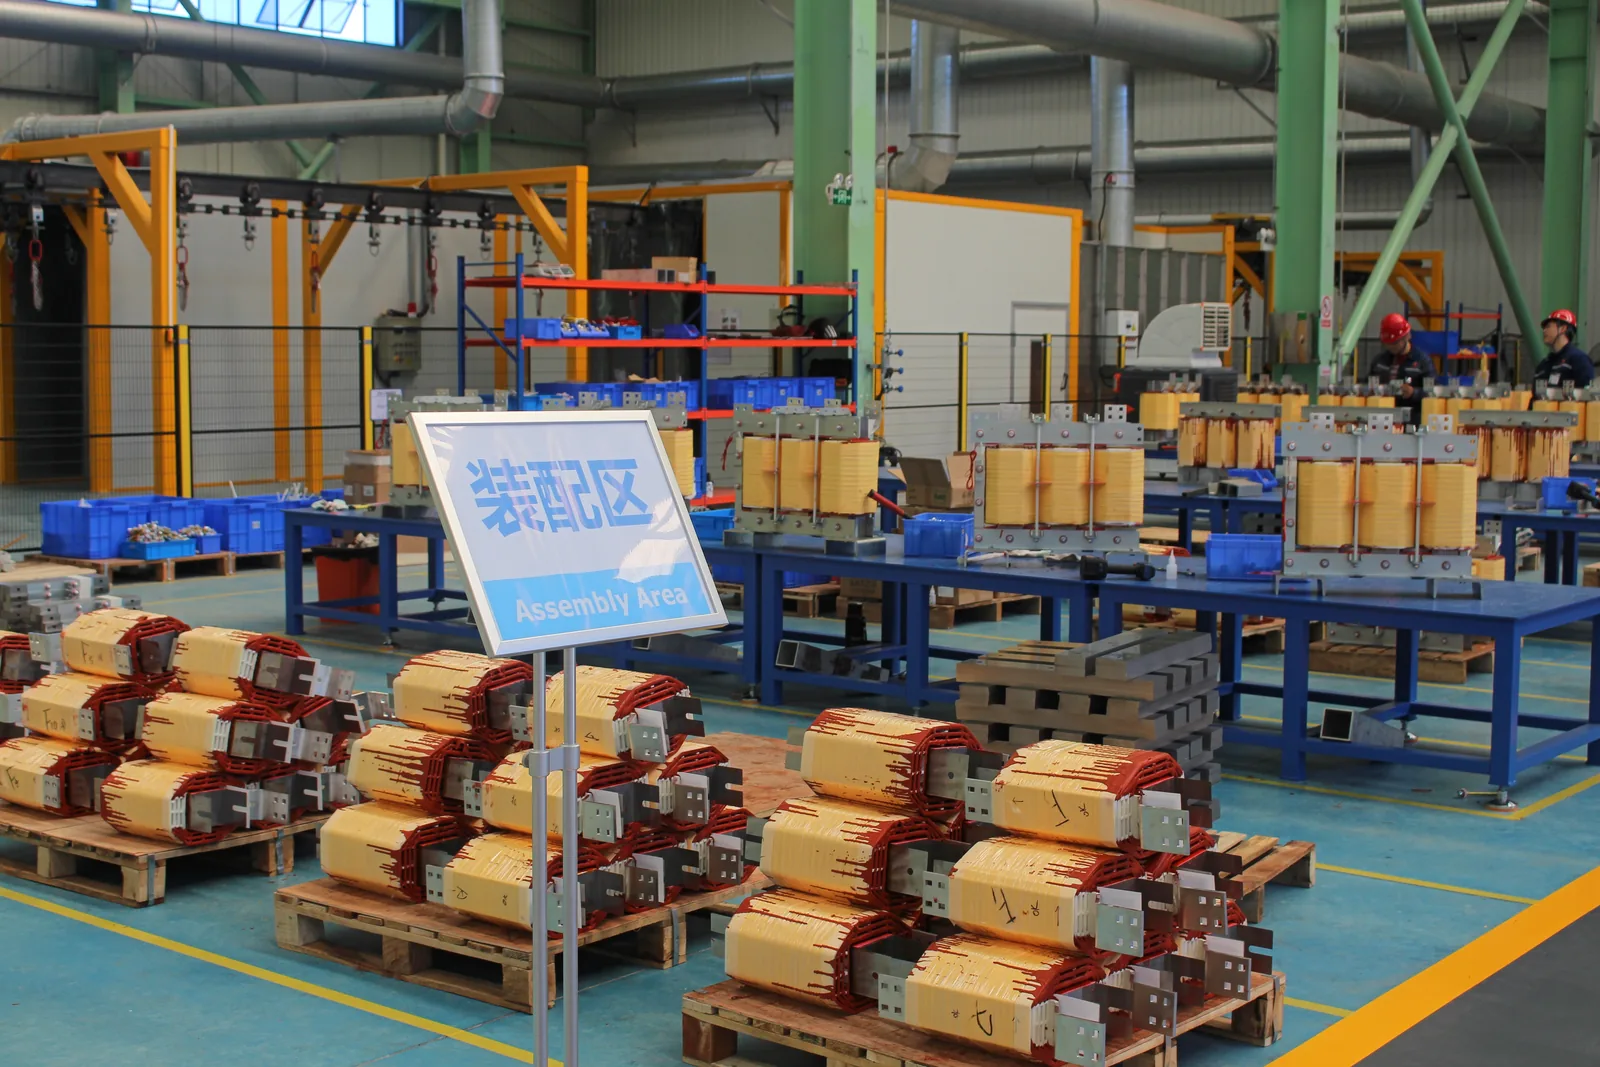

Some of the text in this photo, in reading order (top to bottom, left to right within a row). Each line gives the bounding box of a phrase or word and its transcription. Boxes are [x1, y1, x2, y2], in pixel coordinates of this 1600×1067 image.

[466, 458, 653, 538] 装配区
[516, 586, 689, 623] Assembly Area
